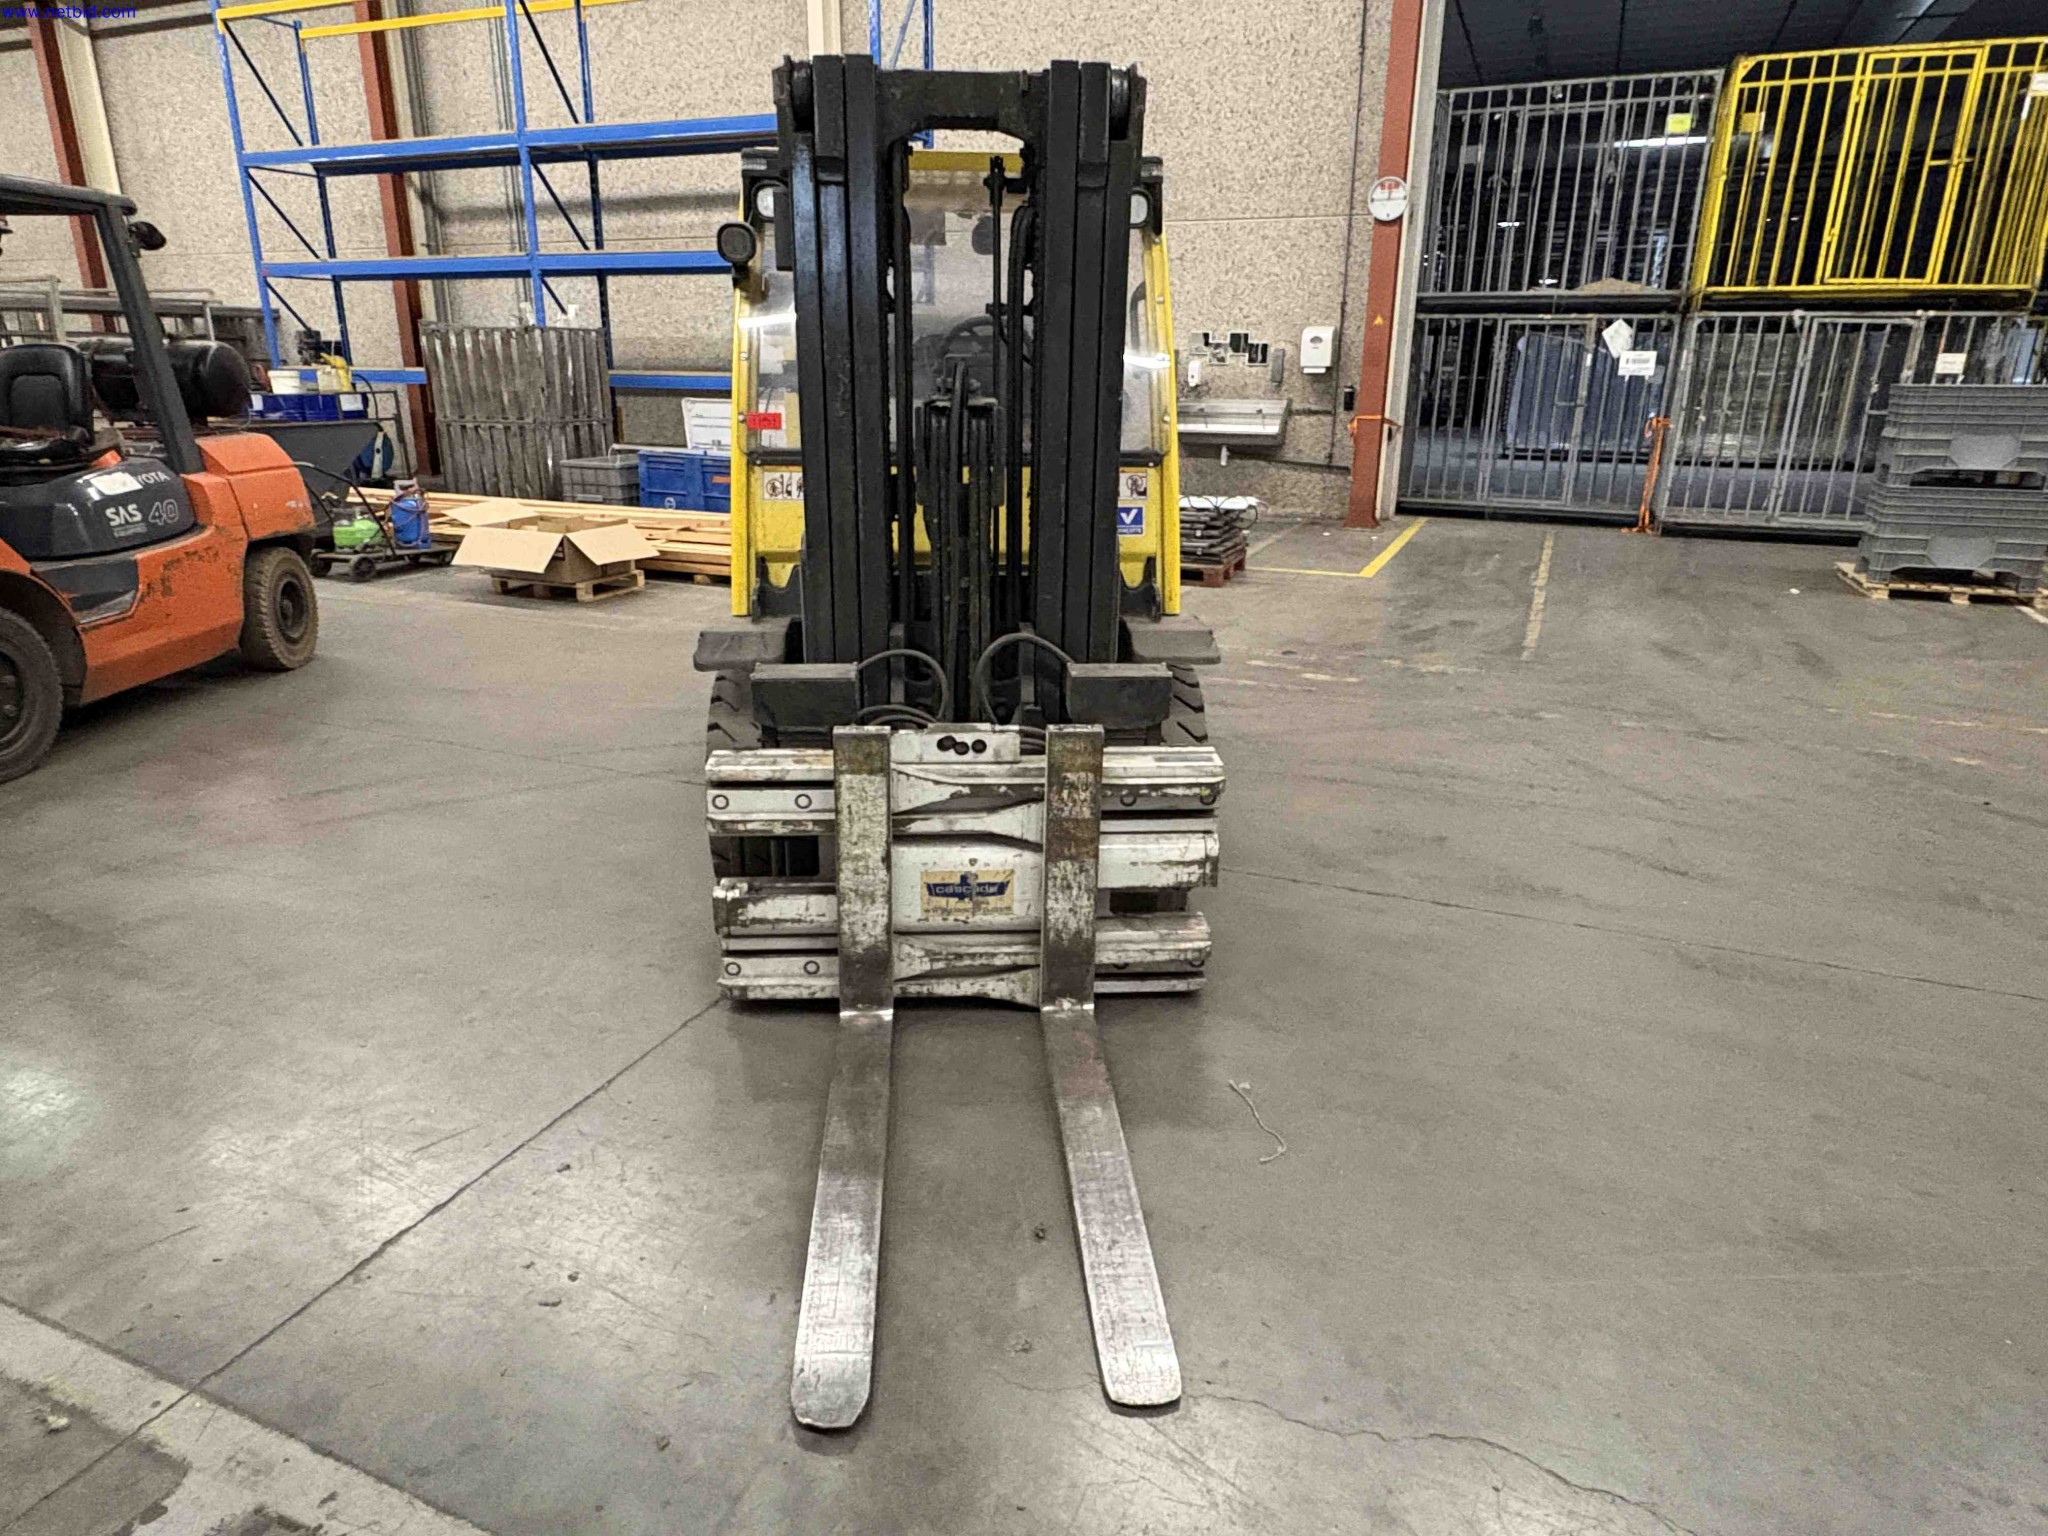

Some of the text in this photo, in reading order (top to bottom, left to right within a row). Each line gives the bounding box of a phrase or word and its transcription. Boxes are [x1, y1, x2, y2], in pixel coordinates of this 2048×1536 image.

[136, 471, 171, 485] YOTA
[105, 499, 179, 526] SAS 40
